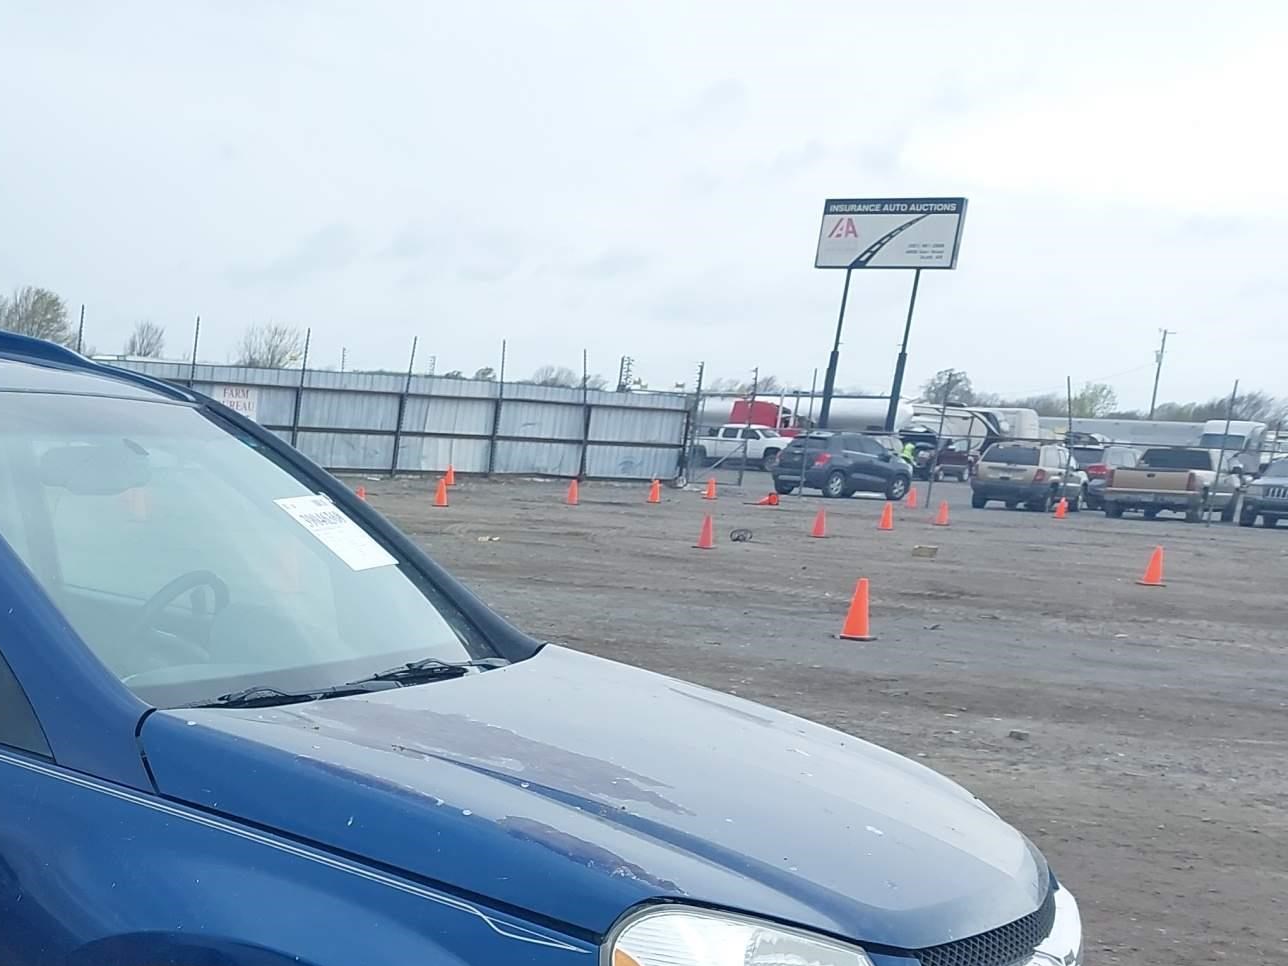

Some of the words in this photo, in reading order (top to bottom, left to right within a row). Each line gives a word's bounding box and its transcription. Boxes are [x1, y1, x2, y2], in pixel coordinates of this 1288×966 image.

[829, 203, 881, 213] INSURANCE
[882, 203, 908, 212] AUTO
[910, 202, 957, 212] AUCTIONS
[223, 387, 249, 399] FARM
[222, 400, 255, 411] UREAU
